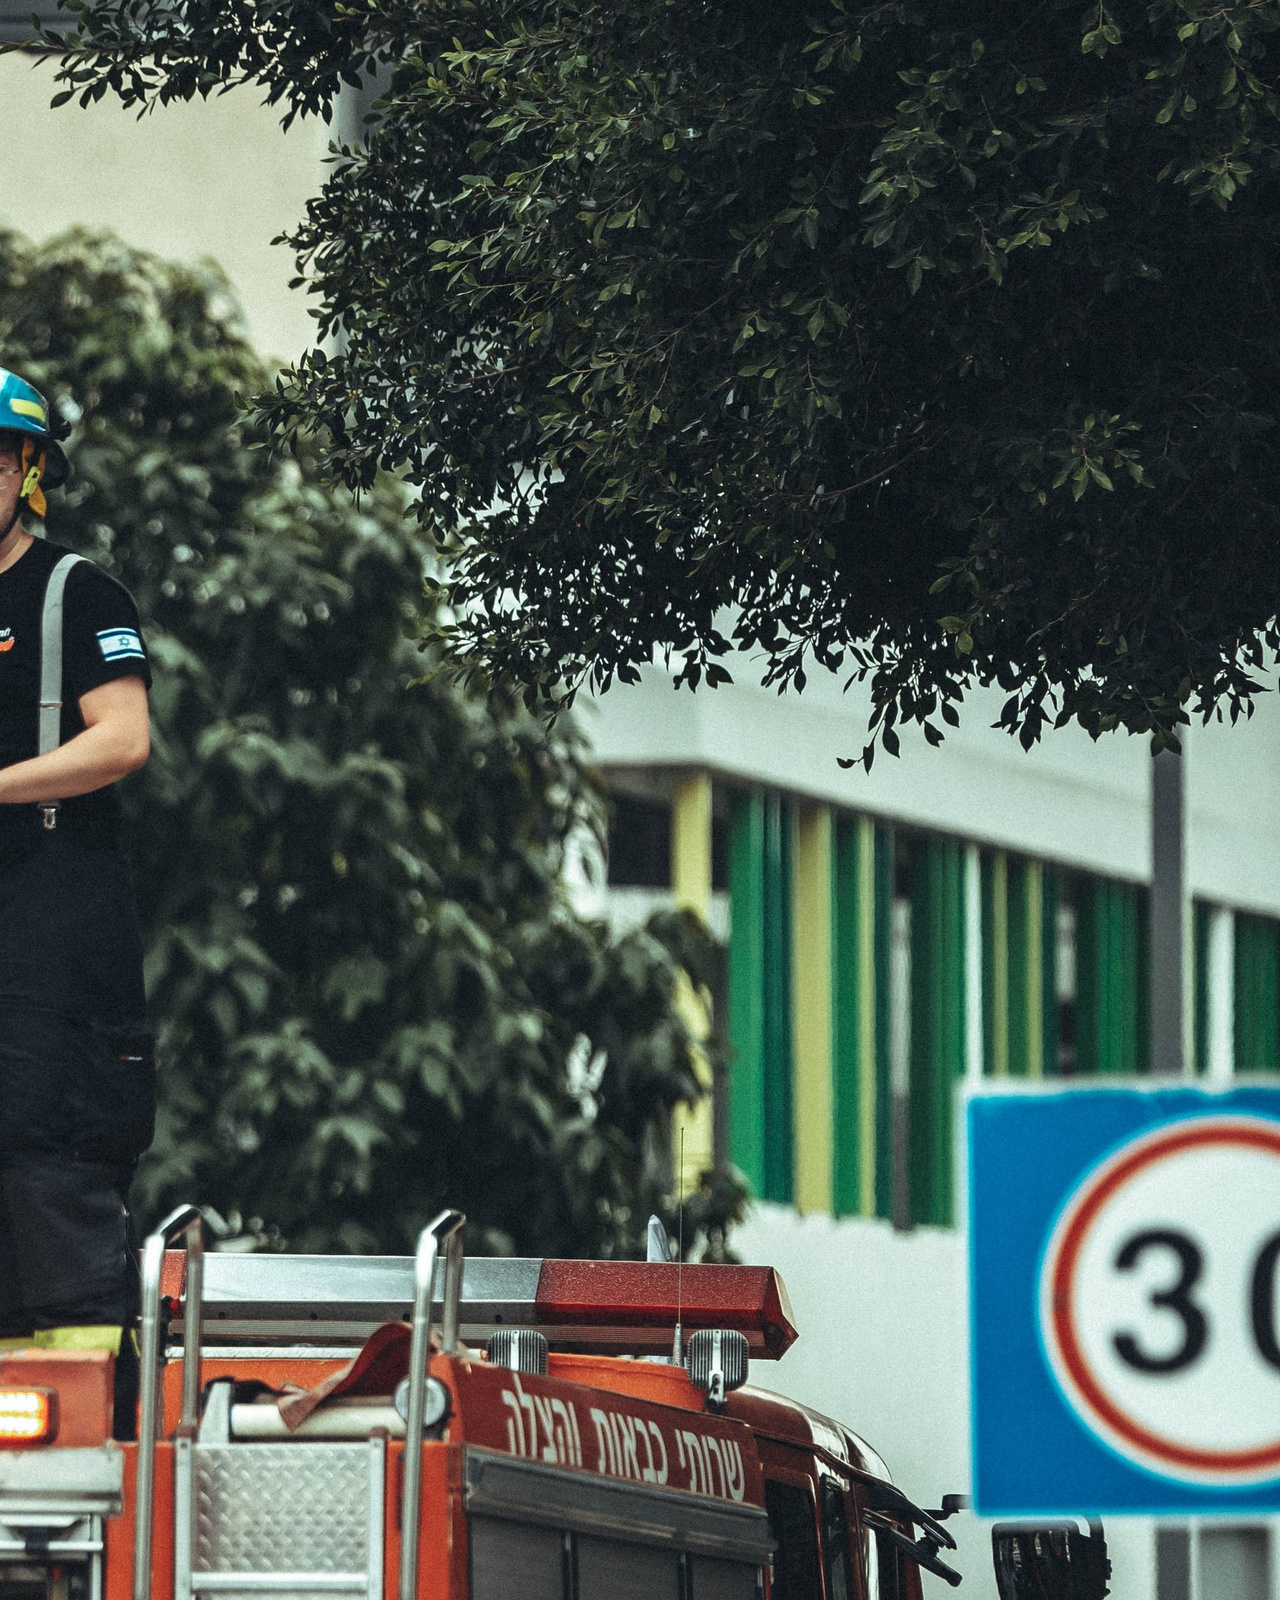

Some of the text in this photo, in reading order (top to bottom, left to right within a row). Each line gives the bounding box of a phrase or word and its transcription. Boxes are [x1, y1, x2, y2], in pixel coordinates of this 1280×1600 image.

[501, 1372, 745, 1502] שרותי כבאות והצלה
